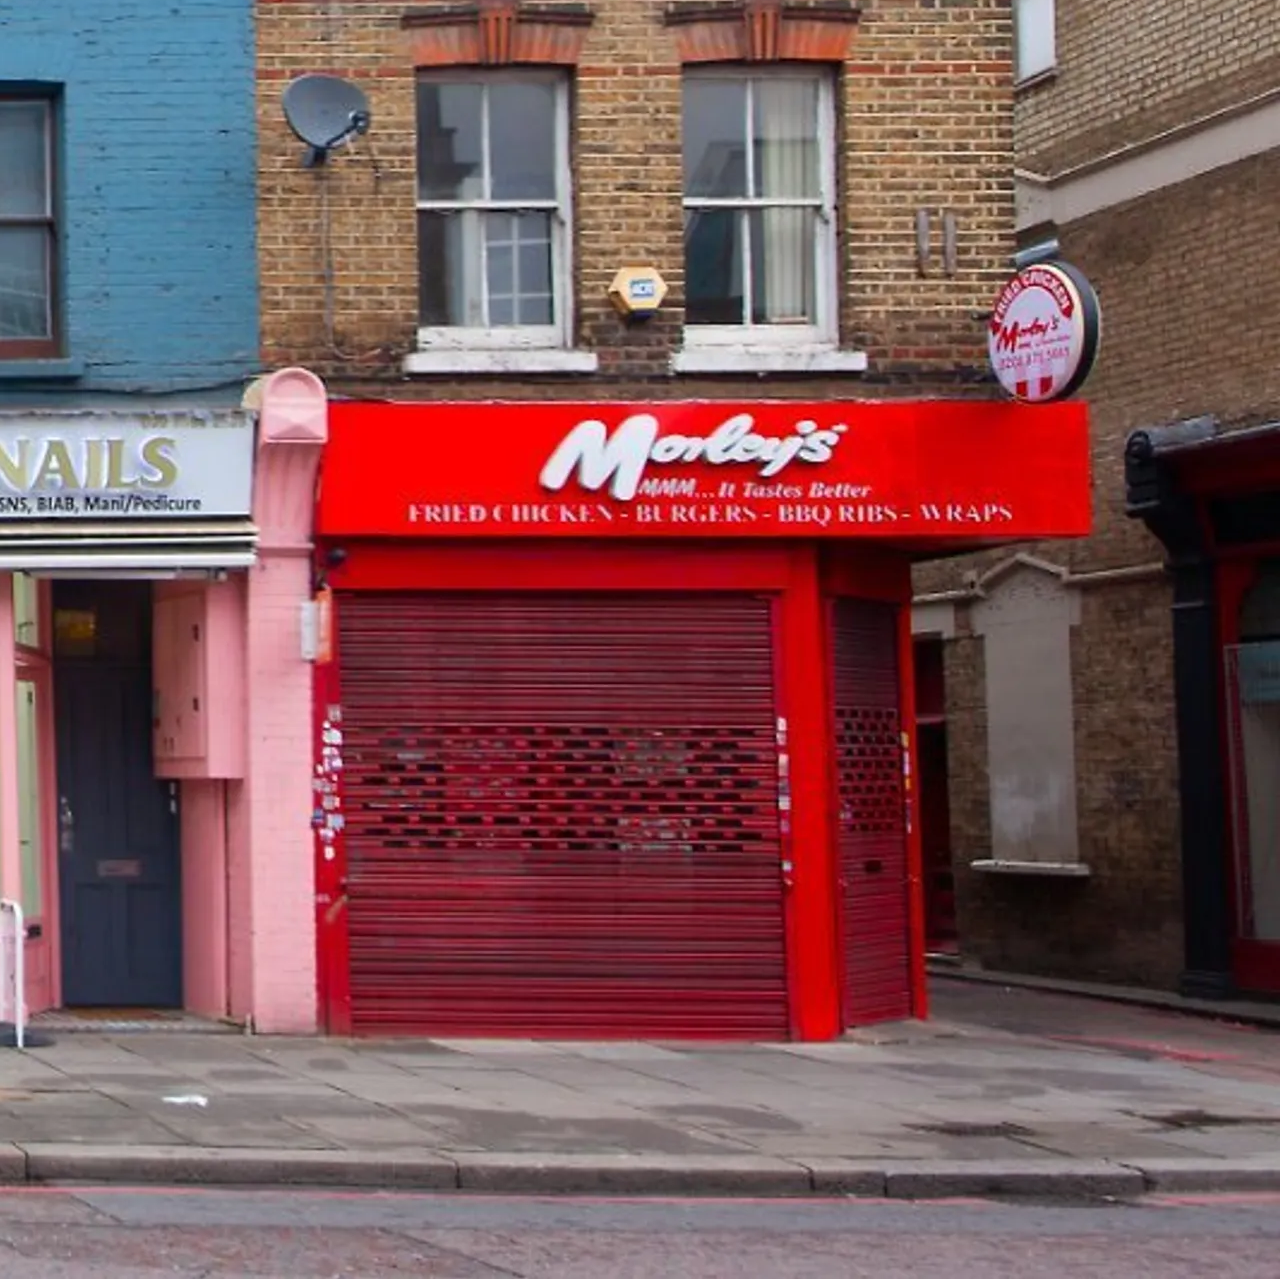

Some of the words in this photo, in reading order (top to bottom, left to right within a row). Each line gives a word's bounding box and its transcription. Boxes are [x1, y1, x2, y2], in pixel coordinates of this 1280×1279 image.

[540, 413, 849, 501] Morley's
[743, 482, 802, 499] Tastes
[808, 482, 873, 499] Better
[408, 504, 487, 522] FRIED
[492, 504, 613, 522] CHICKEN
[636, 504, 757, 522] BURGERS
[778, 504, 831, 526] BBQ
[839, 504, 898, 522] RIBS
[920, 504, 1013, 522] WRAPS
